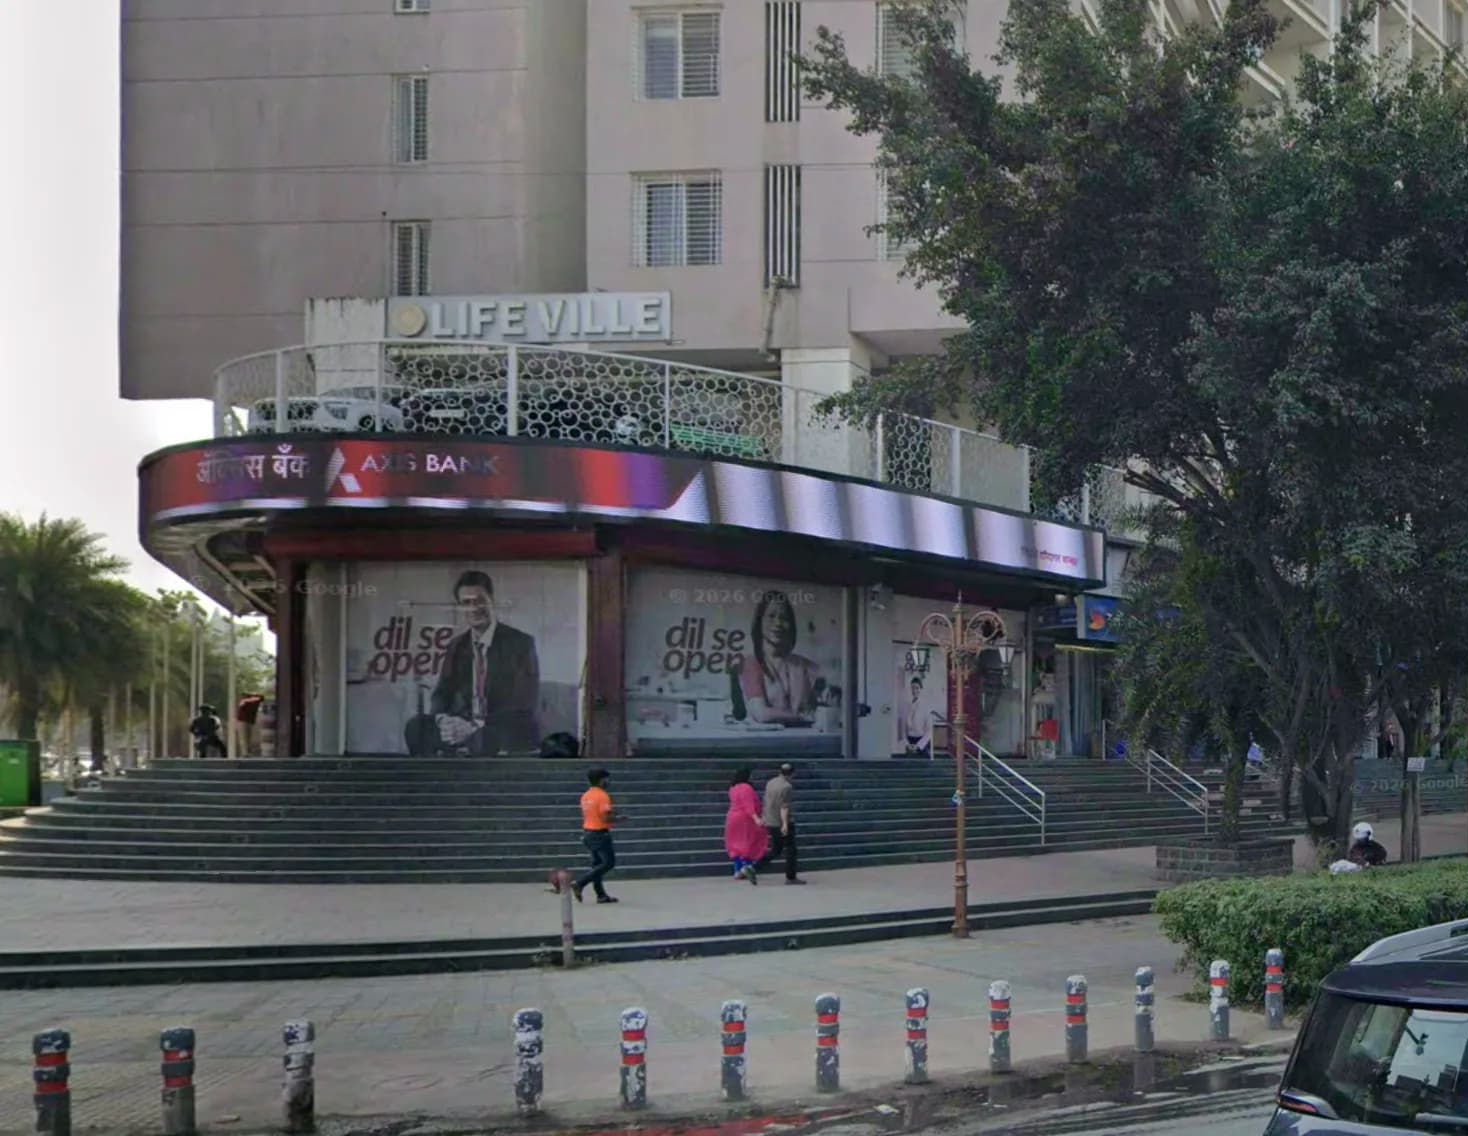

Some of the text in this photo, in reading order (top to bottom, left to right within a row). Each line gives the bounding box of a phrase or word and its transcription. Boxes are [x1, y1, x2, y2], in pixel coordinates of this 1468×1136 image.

[432, 300, 662, 338] LIFE VILLE
[360, 453, 417, 472] AXS
[374, 615, 453, 650] dil se
[665, 616, 746, 651] dil se
[663, 650, 745, 679] open
